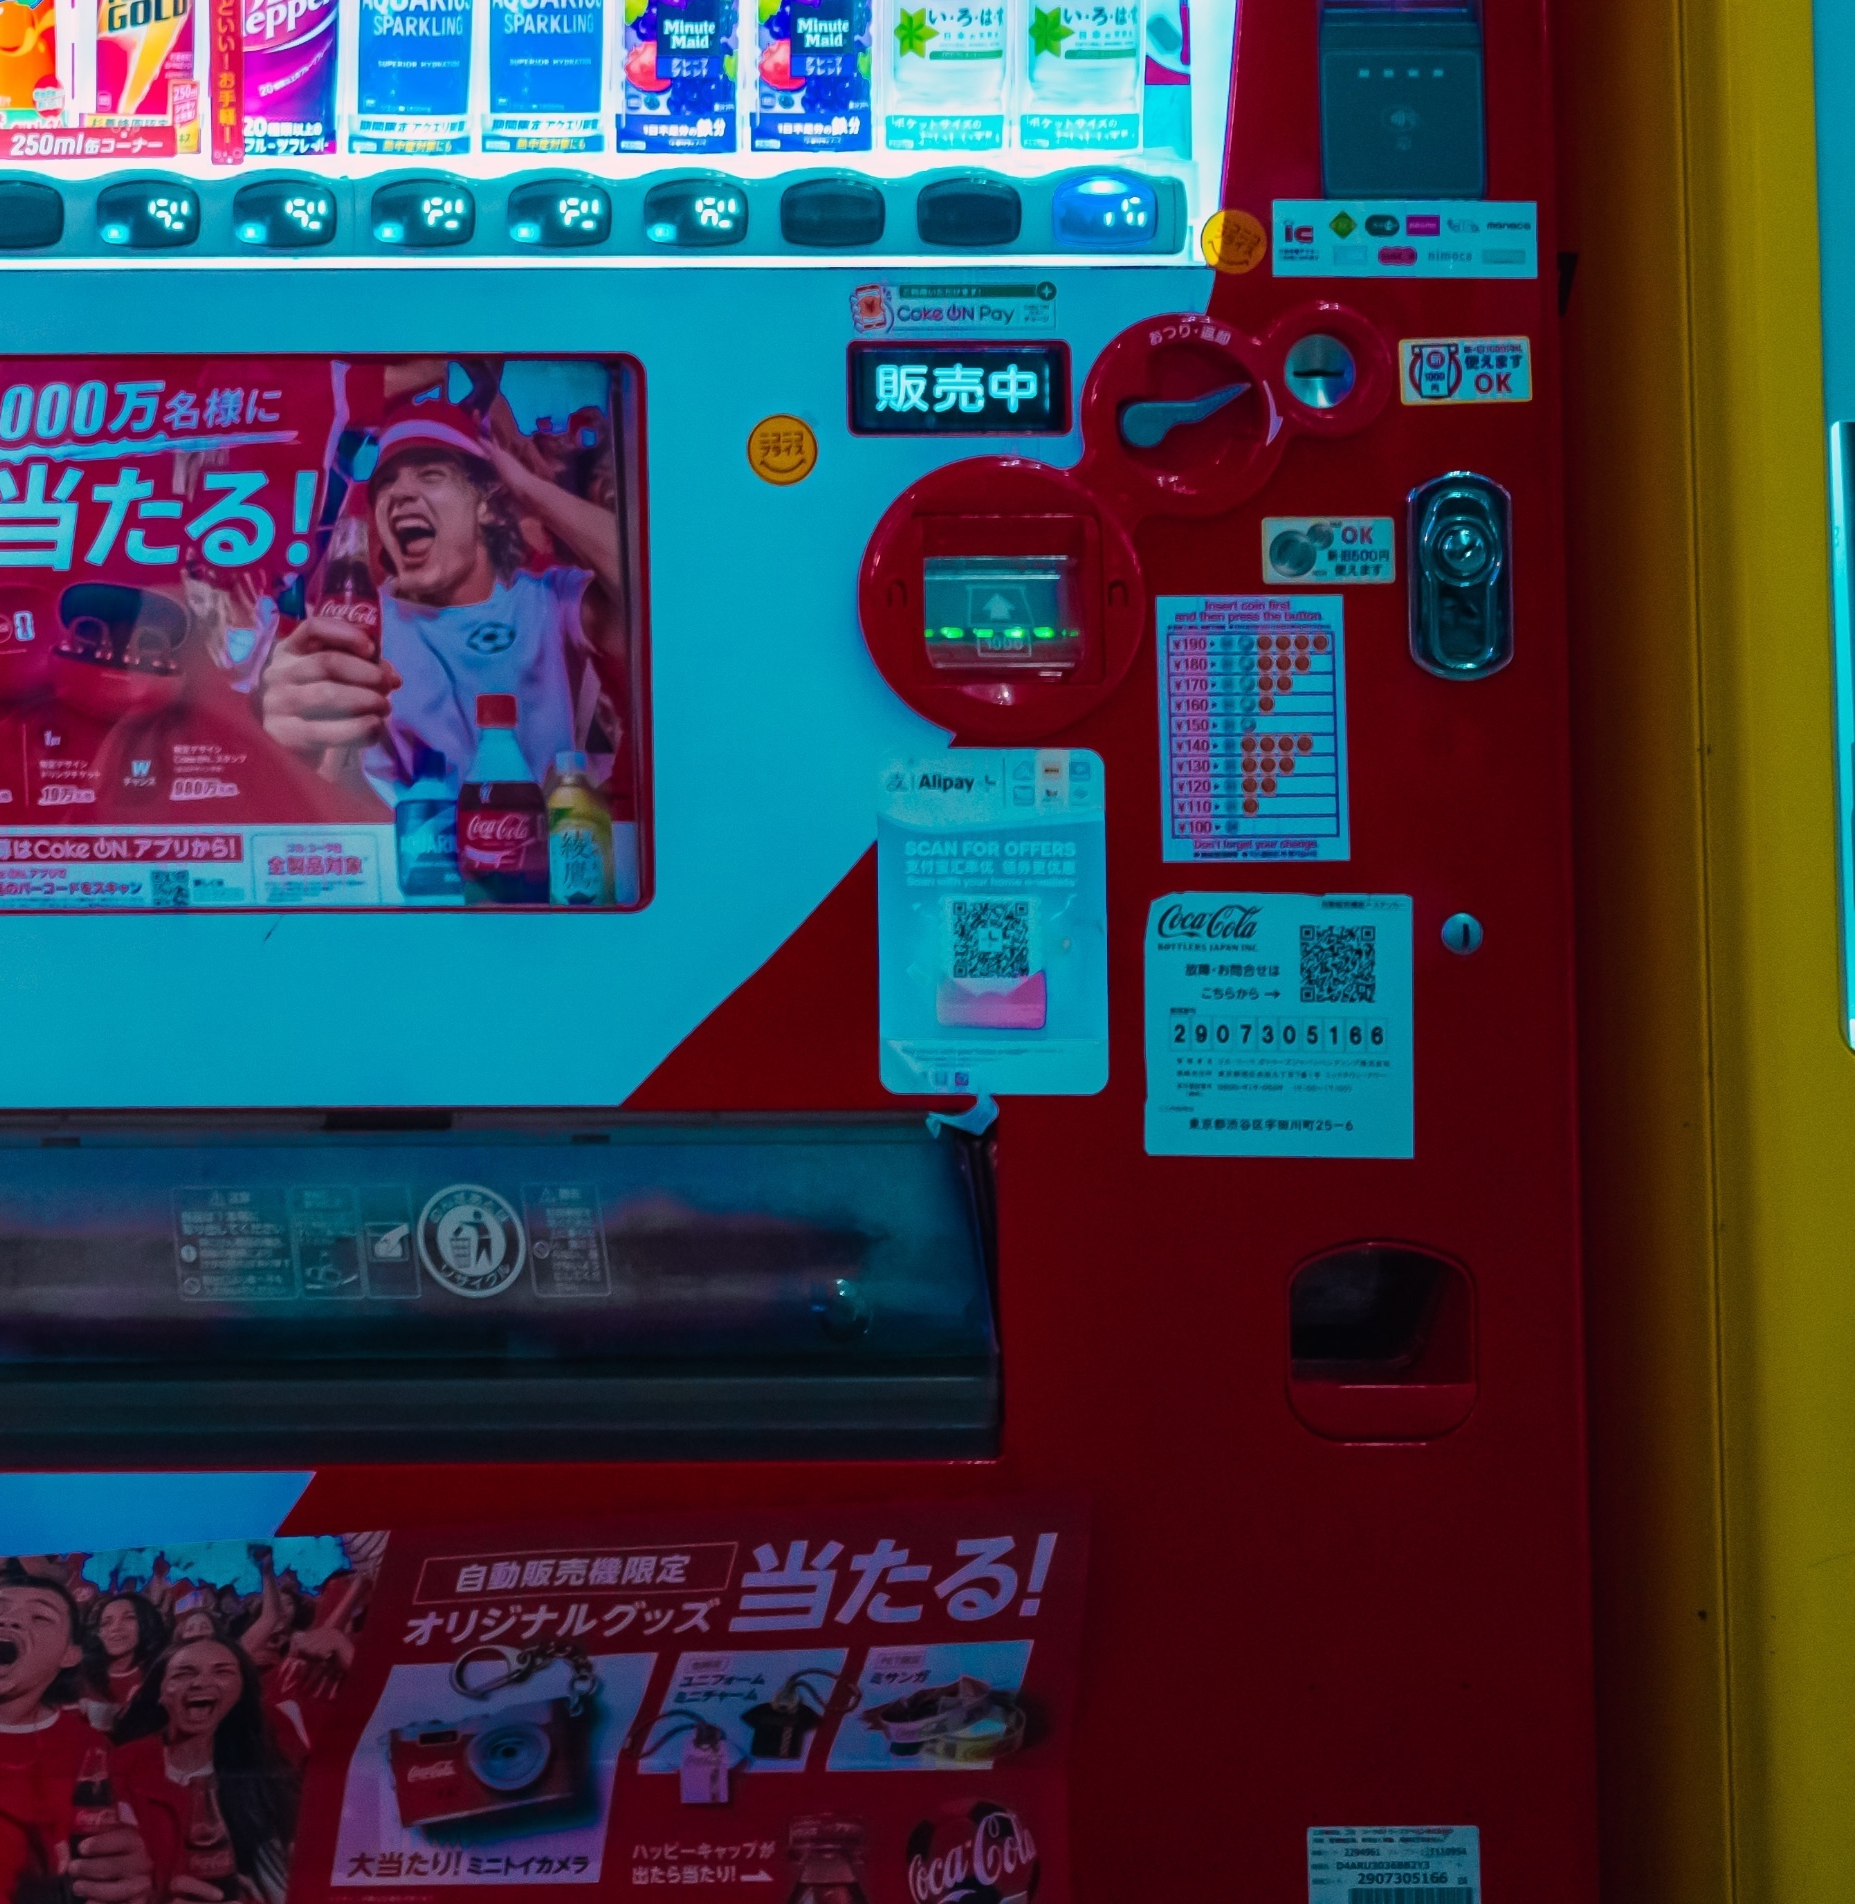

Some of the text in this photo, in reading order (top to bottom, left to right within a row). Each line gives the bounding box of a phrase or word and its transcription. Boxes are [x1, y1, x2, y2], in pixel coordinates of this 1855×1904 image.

[374, 14, 463, 37] SPARKLING
[504, 12, 594, 35] SPARKLING
[663, 17, 716, 35] Minute
[796, 17, 849, 35] Minute
[671, 34, 709, 50] Maid
[804, 33, 843, 50] Maid
[897, 304, 944, 322] Coke
[979, 305, 1016, 325] Pay
[876, 363, 1038, 414] 販売中
[1474, 372, 1513, 394] OK
[1341, 526, 1373, 545] OK
[1200, 611, 1226, 622] then
[1227, 613, 1260, 623] press
[1263, 611, 1282, 622] the
[1284, 611, 1322, 622] button
[1241, 602, 1266, 611] coin
[919, 774, 975, 793] Alipay
[1157, 903, 1264, 940] Coca-Cola
[1173, 1024, 1384, 1045] 2907305166
[455, 1554, 692, 1593] 自動販売機限定
[728, 1532, 1059, 1633] 当たる!
[404, 1598, 722, 1646] オリジナルグッズ
[632, 1840, 776, 1863] ハッピーキャップが
[907, 1808, 1039, 1900] Coca-Cola
[347, 1849, 462, 1879] 大当たり!
[467, 1853, 590, 1876] ミニトイカメラ
